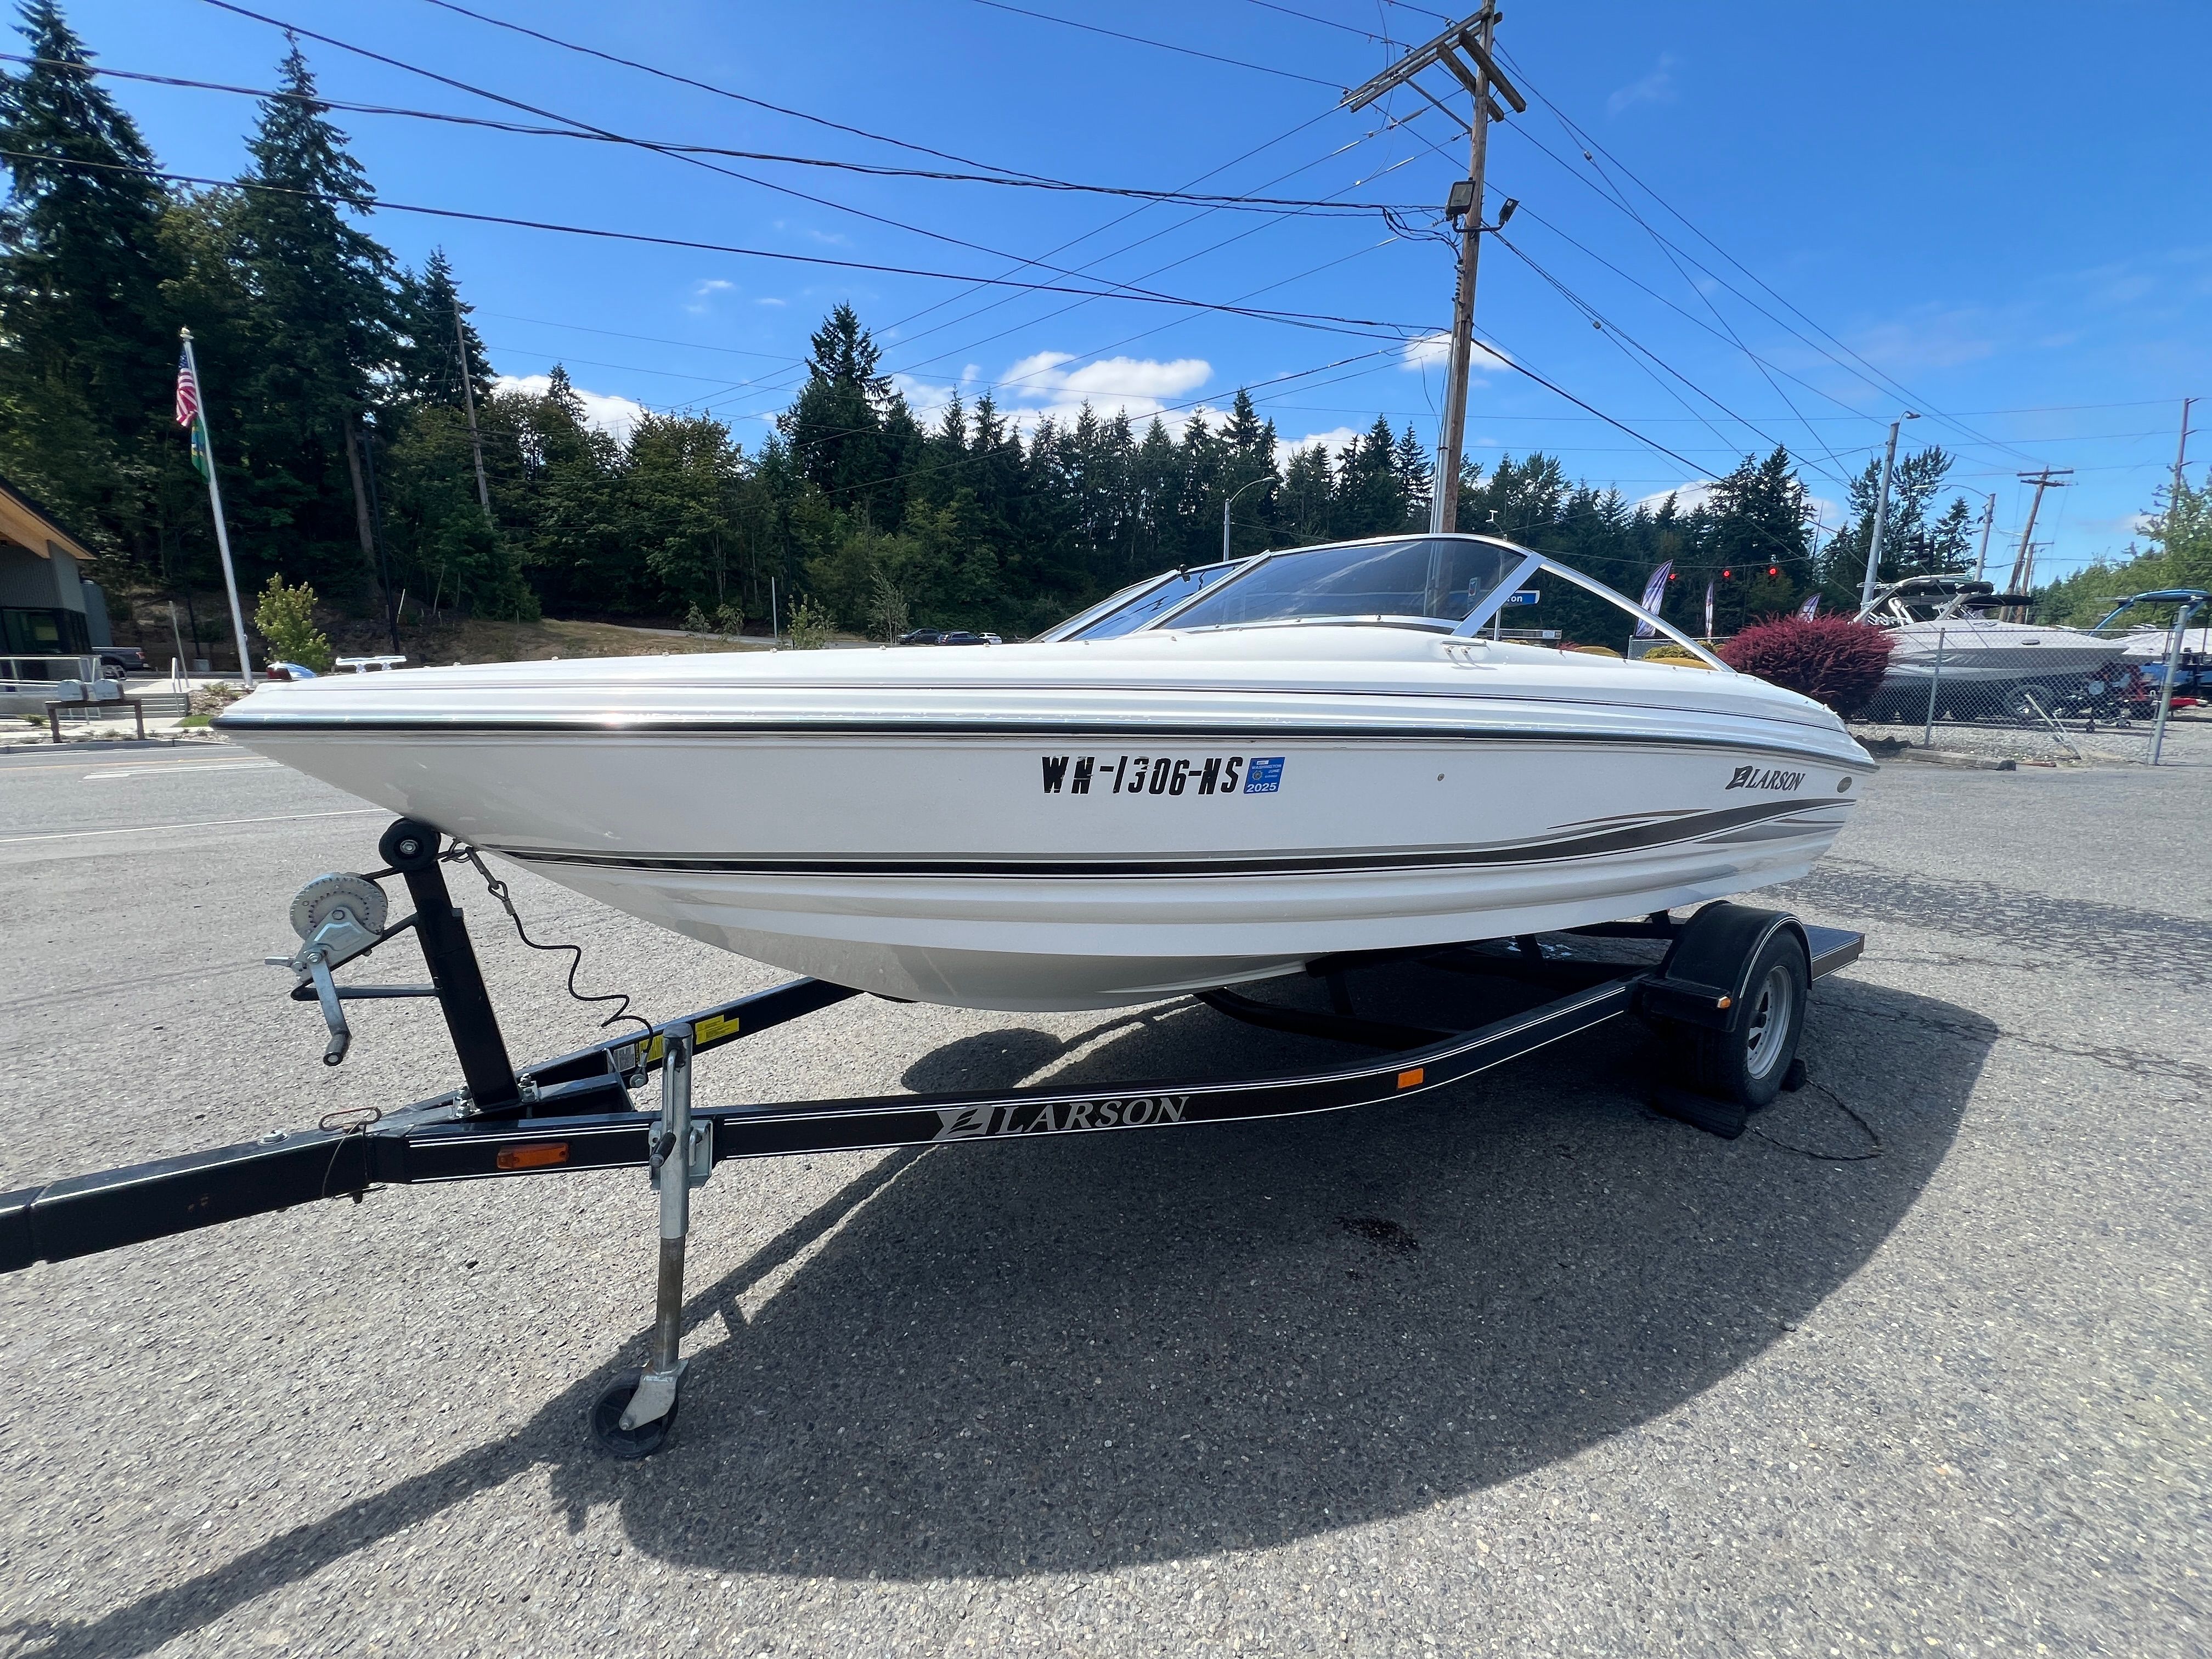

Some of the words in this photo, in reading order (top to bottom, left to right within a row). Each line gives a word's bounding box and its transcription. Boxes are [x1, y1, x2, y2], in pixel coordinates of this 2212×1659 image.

[1246, 782, 1277, 792] 2025
[1745, 768, 1805, 791] LARSON
[995, 1097, 1190, 1135] LARSON
